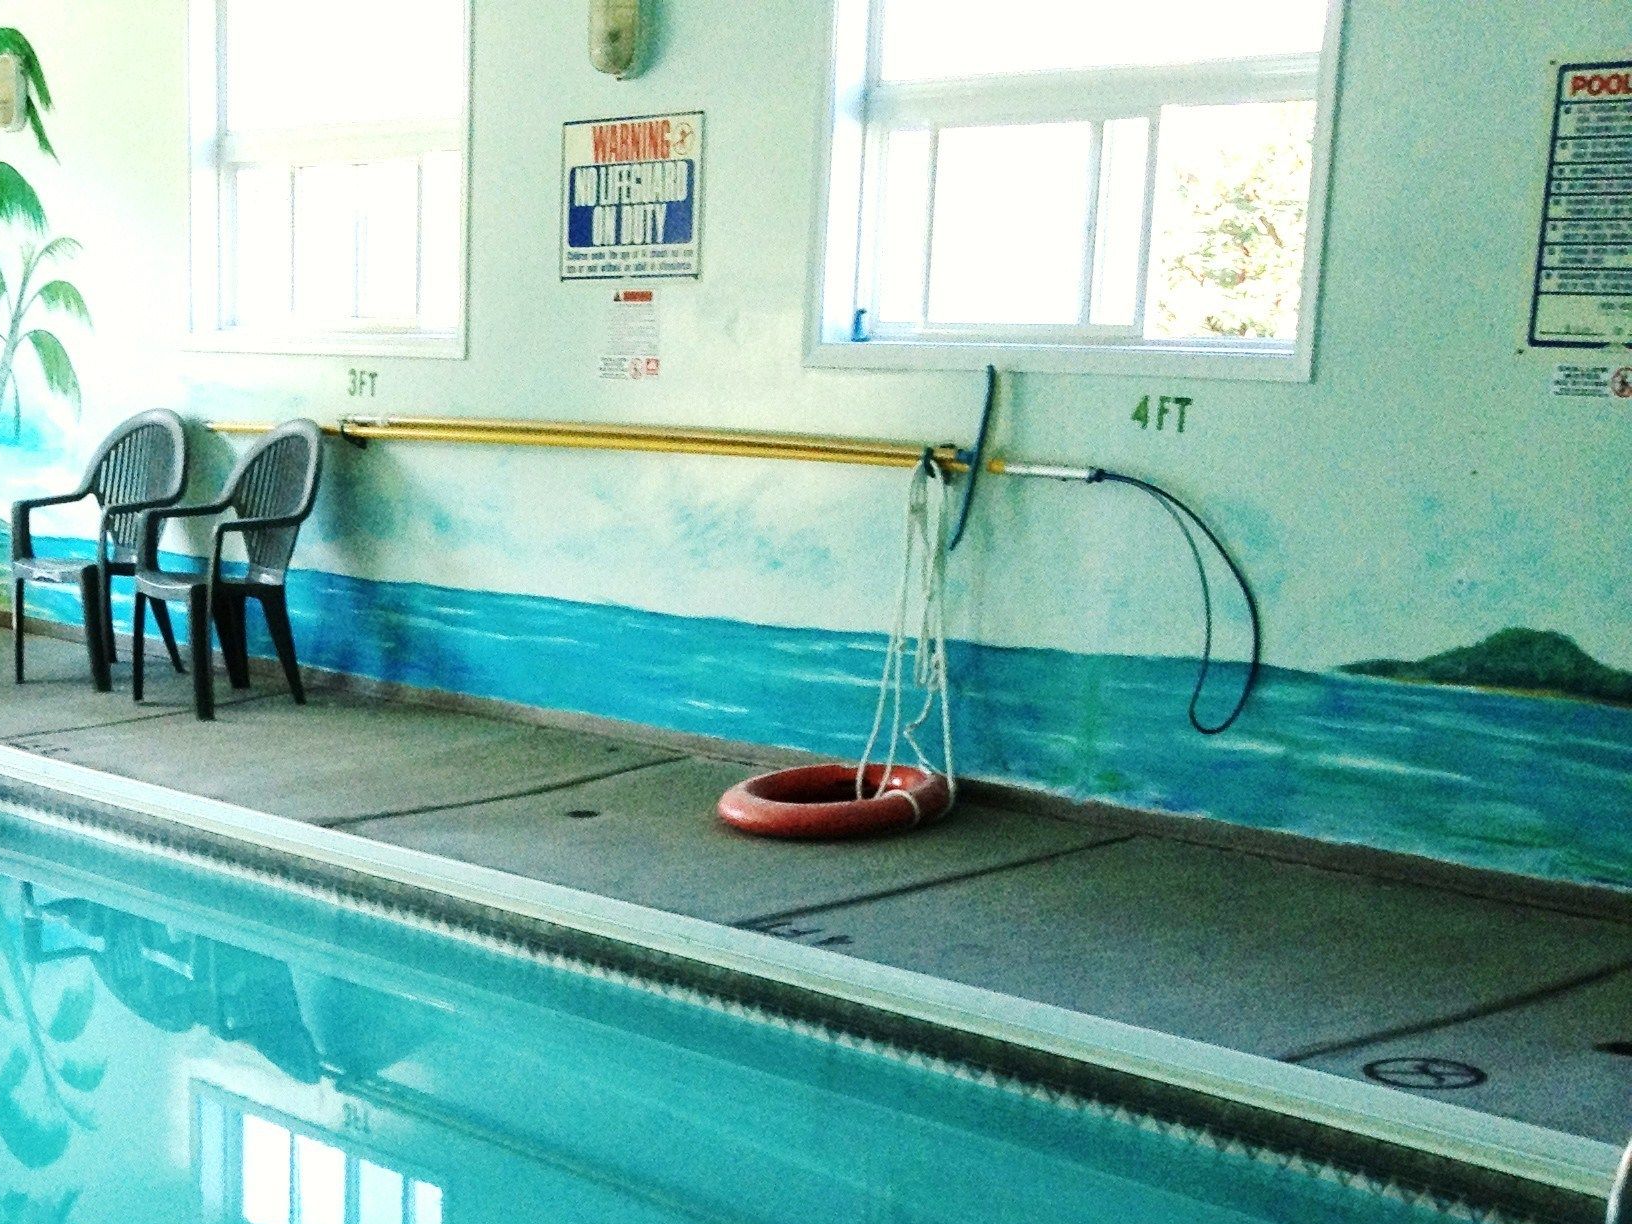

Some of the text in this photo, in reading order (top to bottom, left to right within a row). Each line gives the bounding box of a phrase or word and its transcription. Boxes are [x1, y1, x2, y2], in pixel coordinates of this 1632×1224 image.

[592, 120, 671, 163] WARNING
[574, 161, 688, 206] NO LIFEGUARD
[592, 204, 667, 245] ON DUTY
